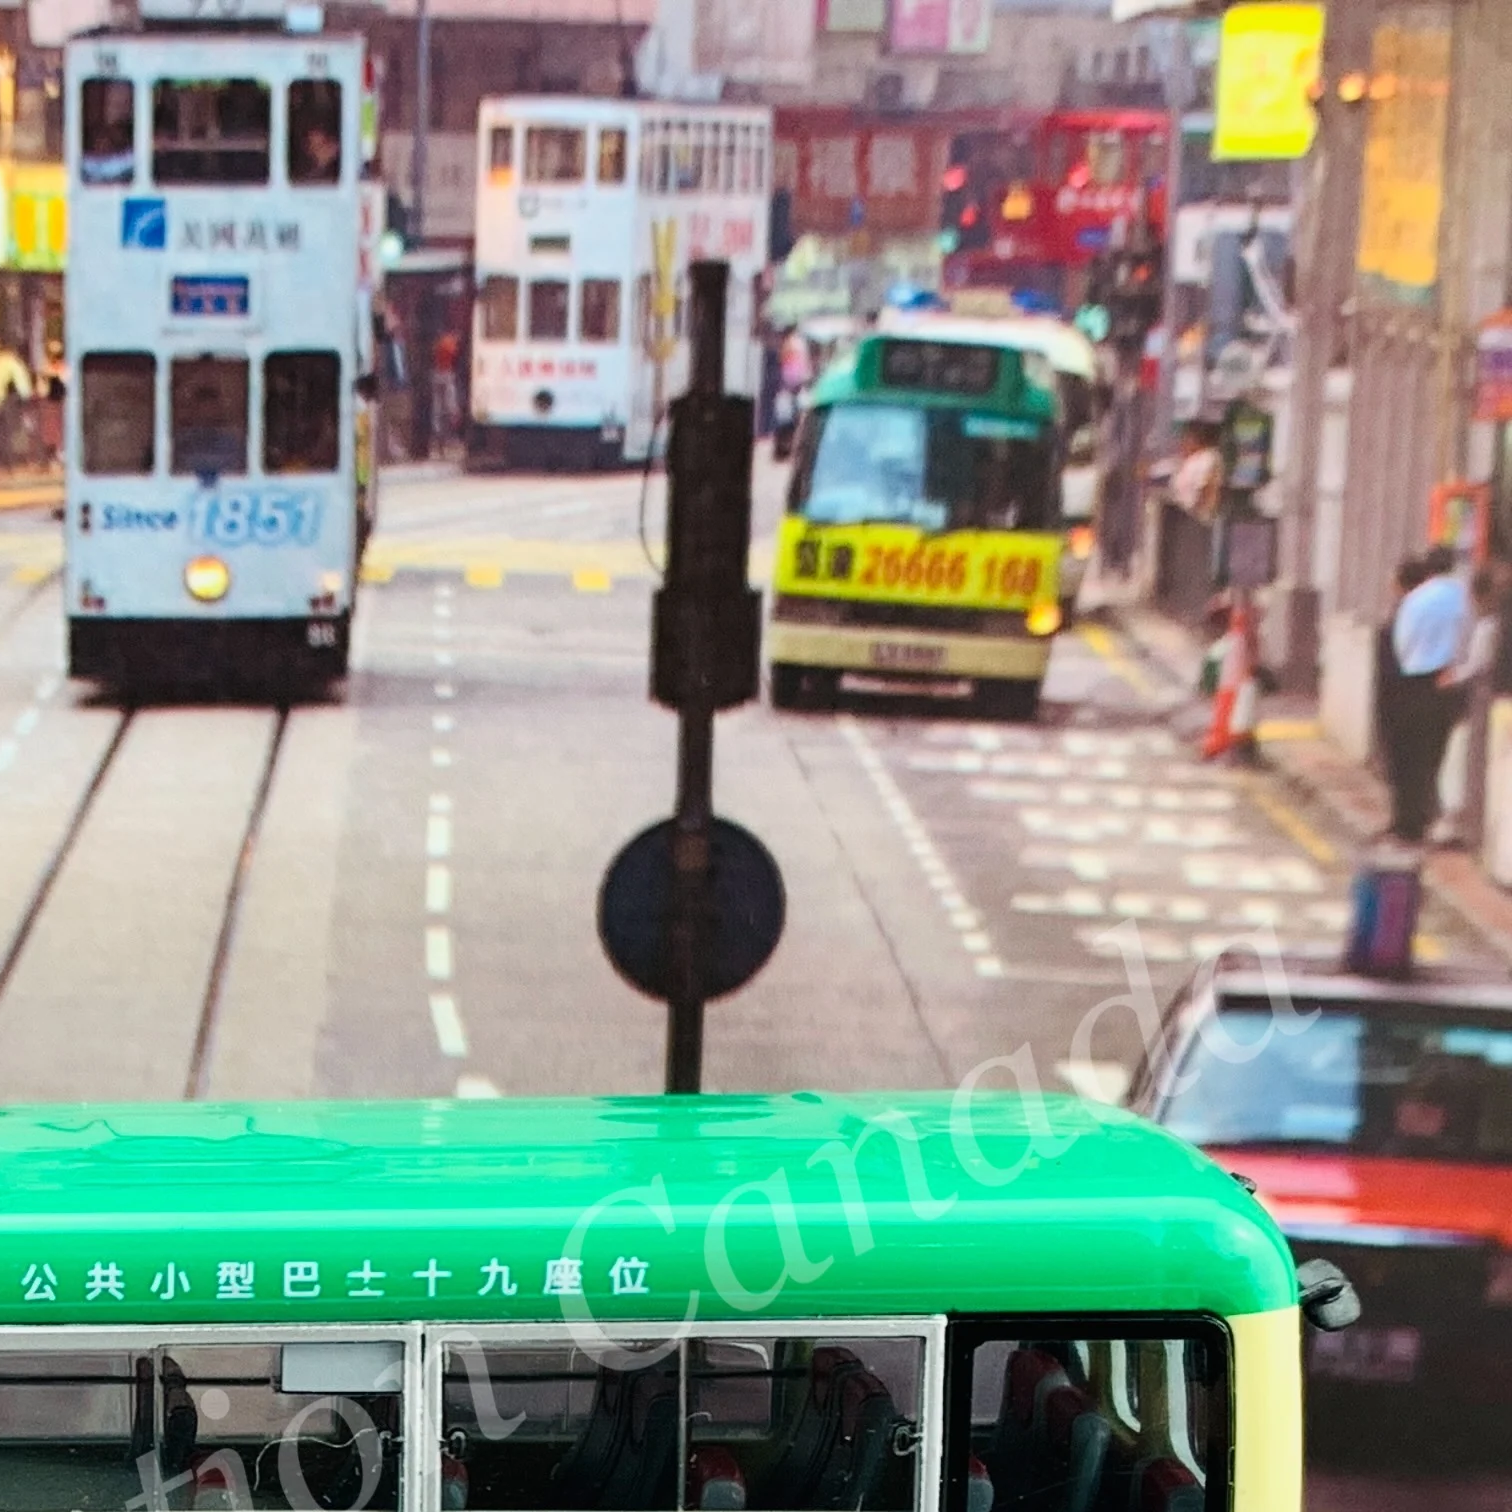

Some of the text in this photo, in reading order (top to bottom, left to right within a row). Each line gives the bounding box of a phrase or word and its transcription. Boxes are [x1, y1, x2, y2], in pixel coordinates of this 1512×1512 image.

[190, 487, 322, 547] 1851
[20, 1256, 652, 1302] 公共小型巴士十九座位
